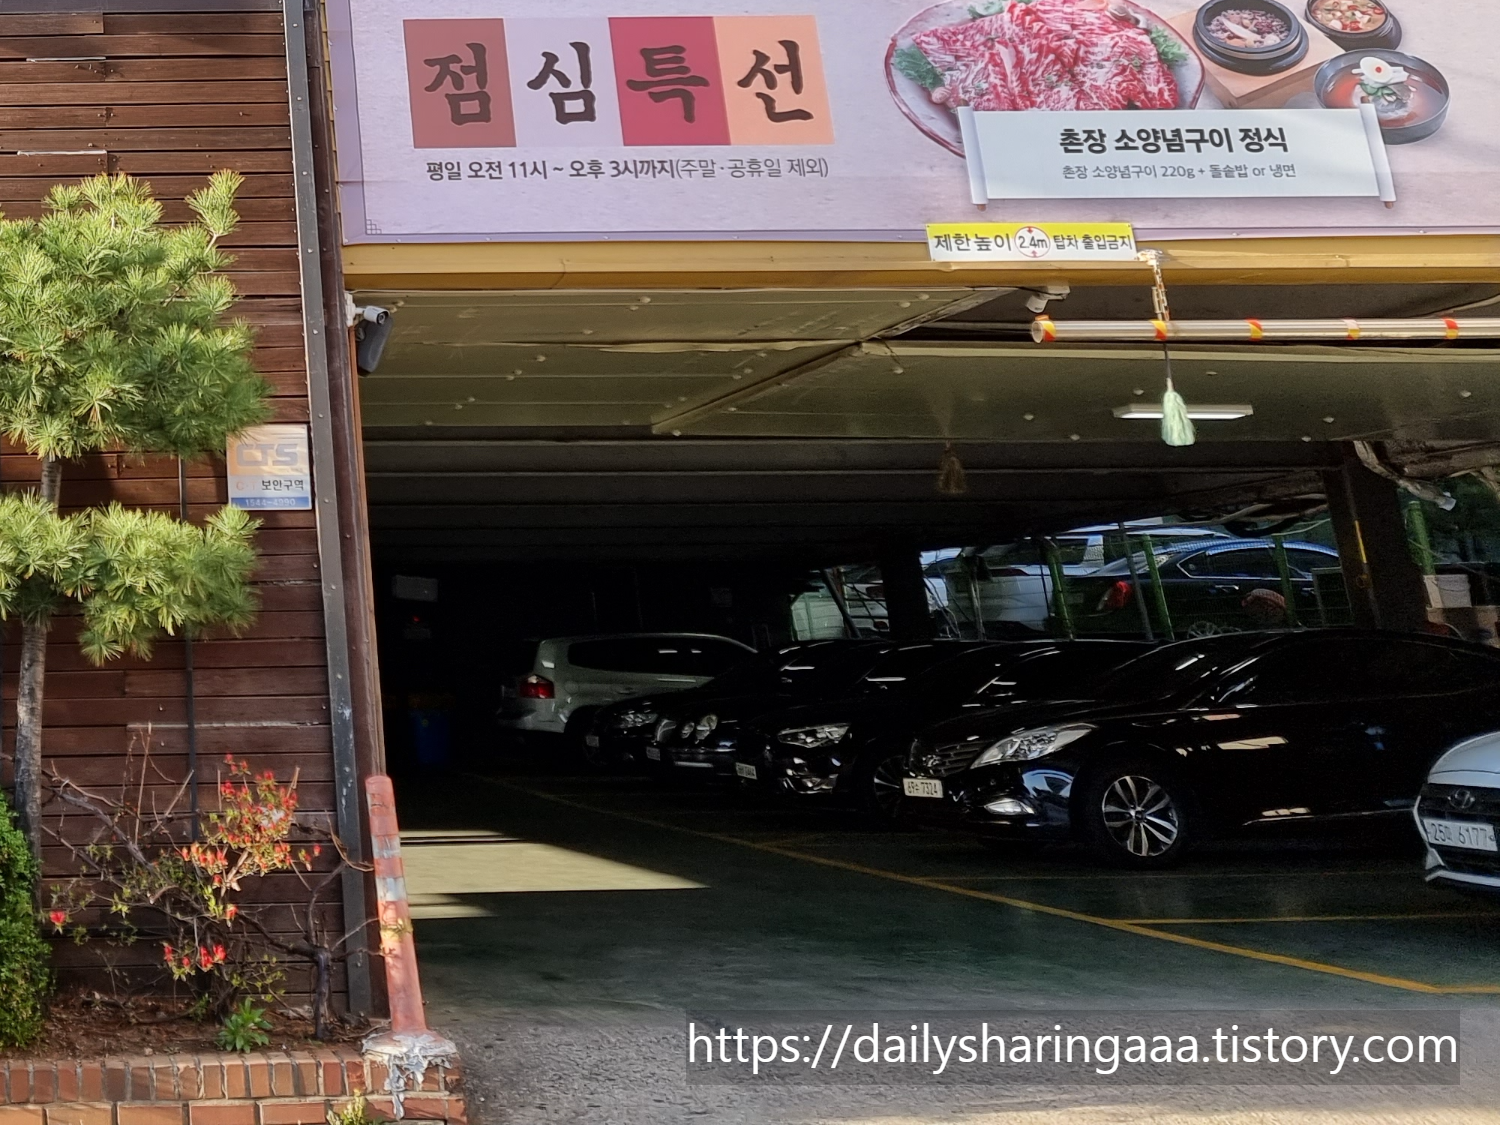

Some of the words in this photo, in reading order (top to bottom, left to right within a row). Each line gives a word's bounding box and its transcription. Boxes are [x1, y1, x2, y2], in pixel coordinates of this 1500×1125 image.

[1059, 128, 1107, 154] 촌장
[1114, 127, 1234, 154] 소양념구이
[1239, 127, 1289, 153] 정식
[426, 161, 462, 181] 평일
[468, 161, 503, 180] 오전
[508, 160, 548, 180] 11시
[569, 160, 605, 179] 오후
[787, 158, 829, 179] 제외)
[1062, 165, 1088, 180] 촌장
[1092, 165, 1157, 179] 소양념구이
[1160, 165, 1196, 179] 220g
[1209, 164, 1249, 179] 돌솥밥
[1252, 166, 1266, 177] or
[1269, 164, 1297, 179] 냉면
[1018, 235, 1049, 250] 2.4m
[1053, 234, 1079, 251] 탑차
[1081, 233, 1133, 250] 출입금지
[262, 480, 304, 491] 보안구역
